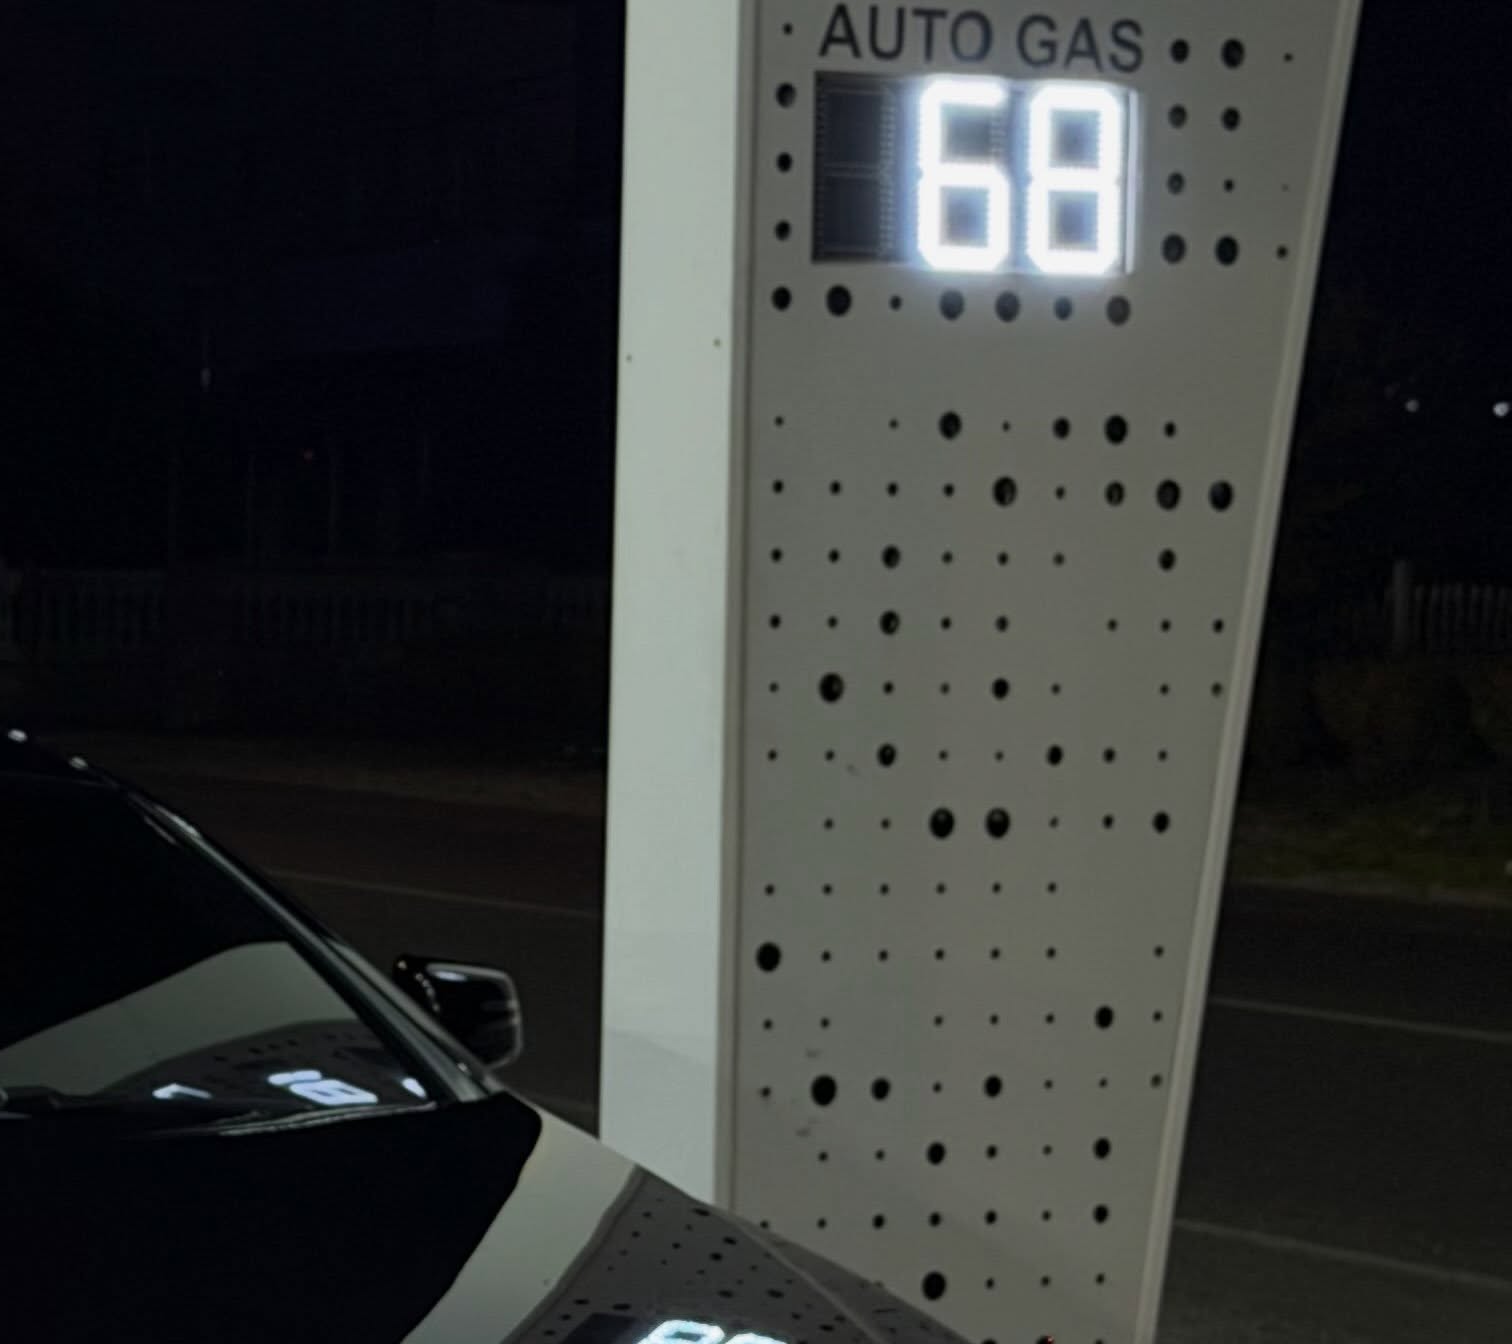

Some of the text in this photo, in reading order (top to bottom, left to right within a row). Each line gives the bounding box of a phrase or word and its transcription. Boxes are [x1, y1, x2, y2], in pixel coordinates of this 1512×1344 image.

[818, 3, 1145, 73] AUTO GAS
[915, 76, 1123, 274] 68
